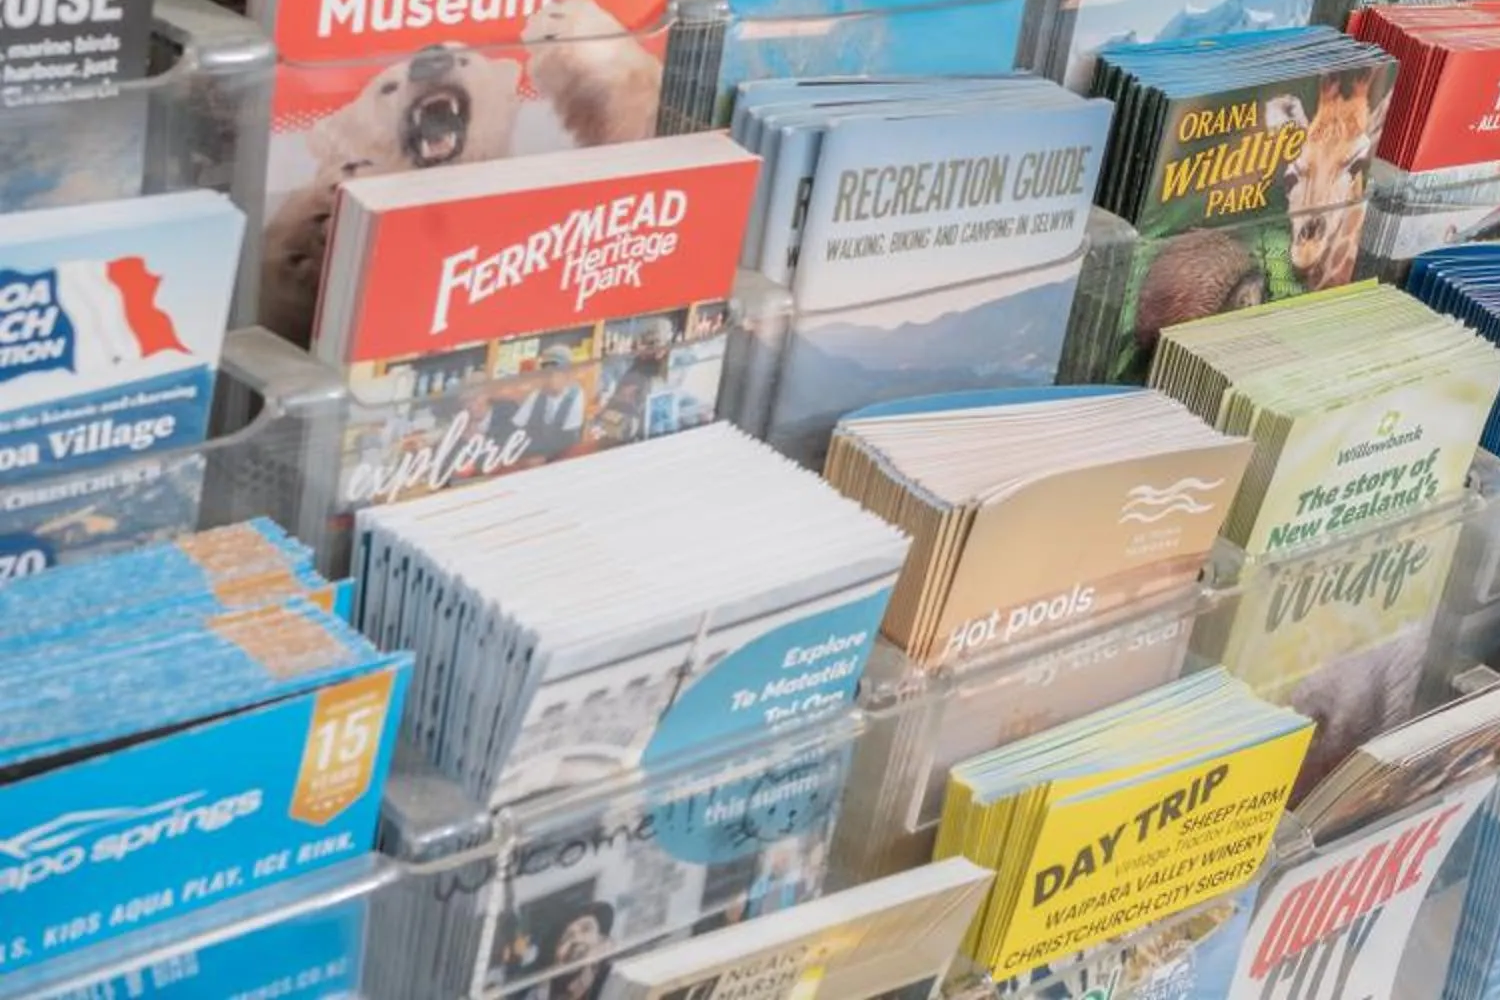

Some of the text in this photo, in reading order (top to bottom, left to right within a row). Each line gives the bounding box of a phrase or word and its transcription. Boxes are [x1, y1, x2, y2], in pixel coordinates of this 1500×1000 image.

[1177, 101, 1258, 145] ORANA
[831, 145, 1093, 224] RECREATION GUIDE
[1160, 119, 1309, 203] Wildlife
[1204, 182, 1271, 220] PARK
[430, 189, 688, 336] FERRYMEAD
[560, 230, 679, 291] Heritage
[574, 257, 641, 312] Park
[48, 415, 176, 458] Village
[1337, 423, 1424, 467] Willowbank
[1267, 473, 1440, 551] New Zealand's
[1298, 448, 1440, 517] The story of
[944, 583, 1096, 658] Hot pools
[1266, 539, 1430, 634] Wildlife
[783, 630, 867, 668] Explore
[316, 708, 373, 768] 15
[1032, 763, 1230, 908] DAY TRIP
[1178, 785, 1288, 837] SHEEP FARM
[1003, 858, 1258, 972] CHRISTCHURCH CITY SIGHTS
[1044, 830, 1267, 929] WAIPARA VALLEY WINERY
[1249, 802, 1465, 980] QUAKE
